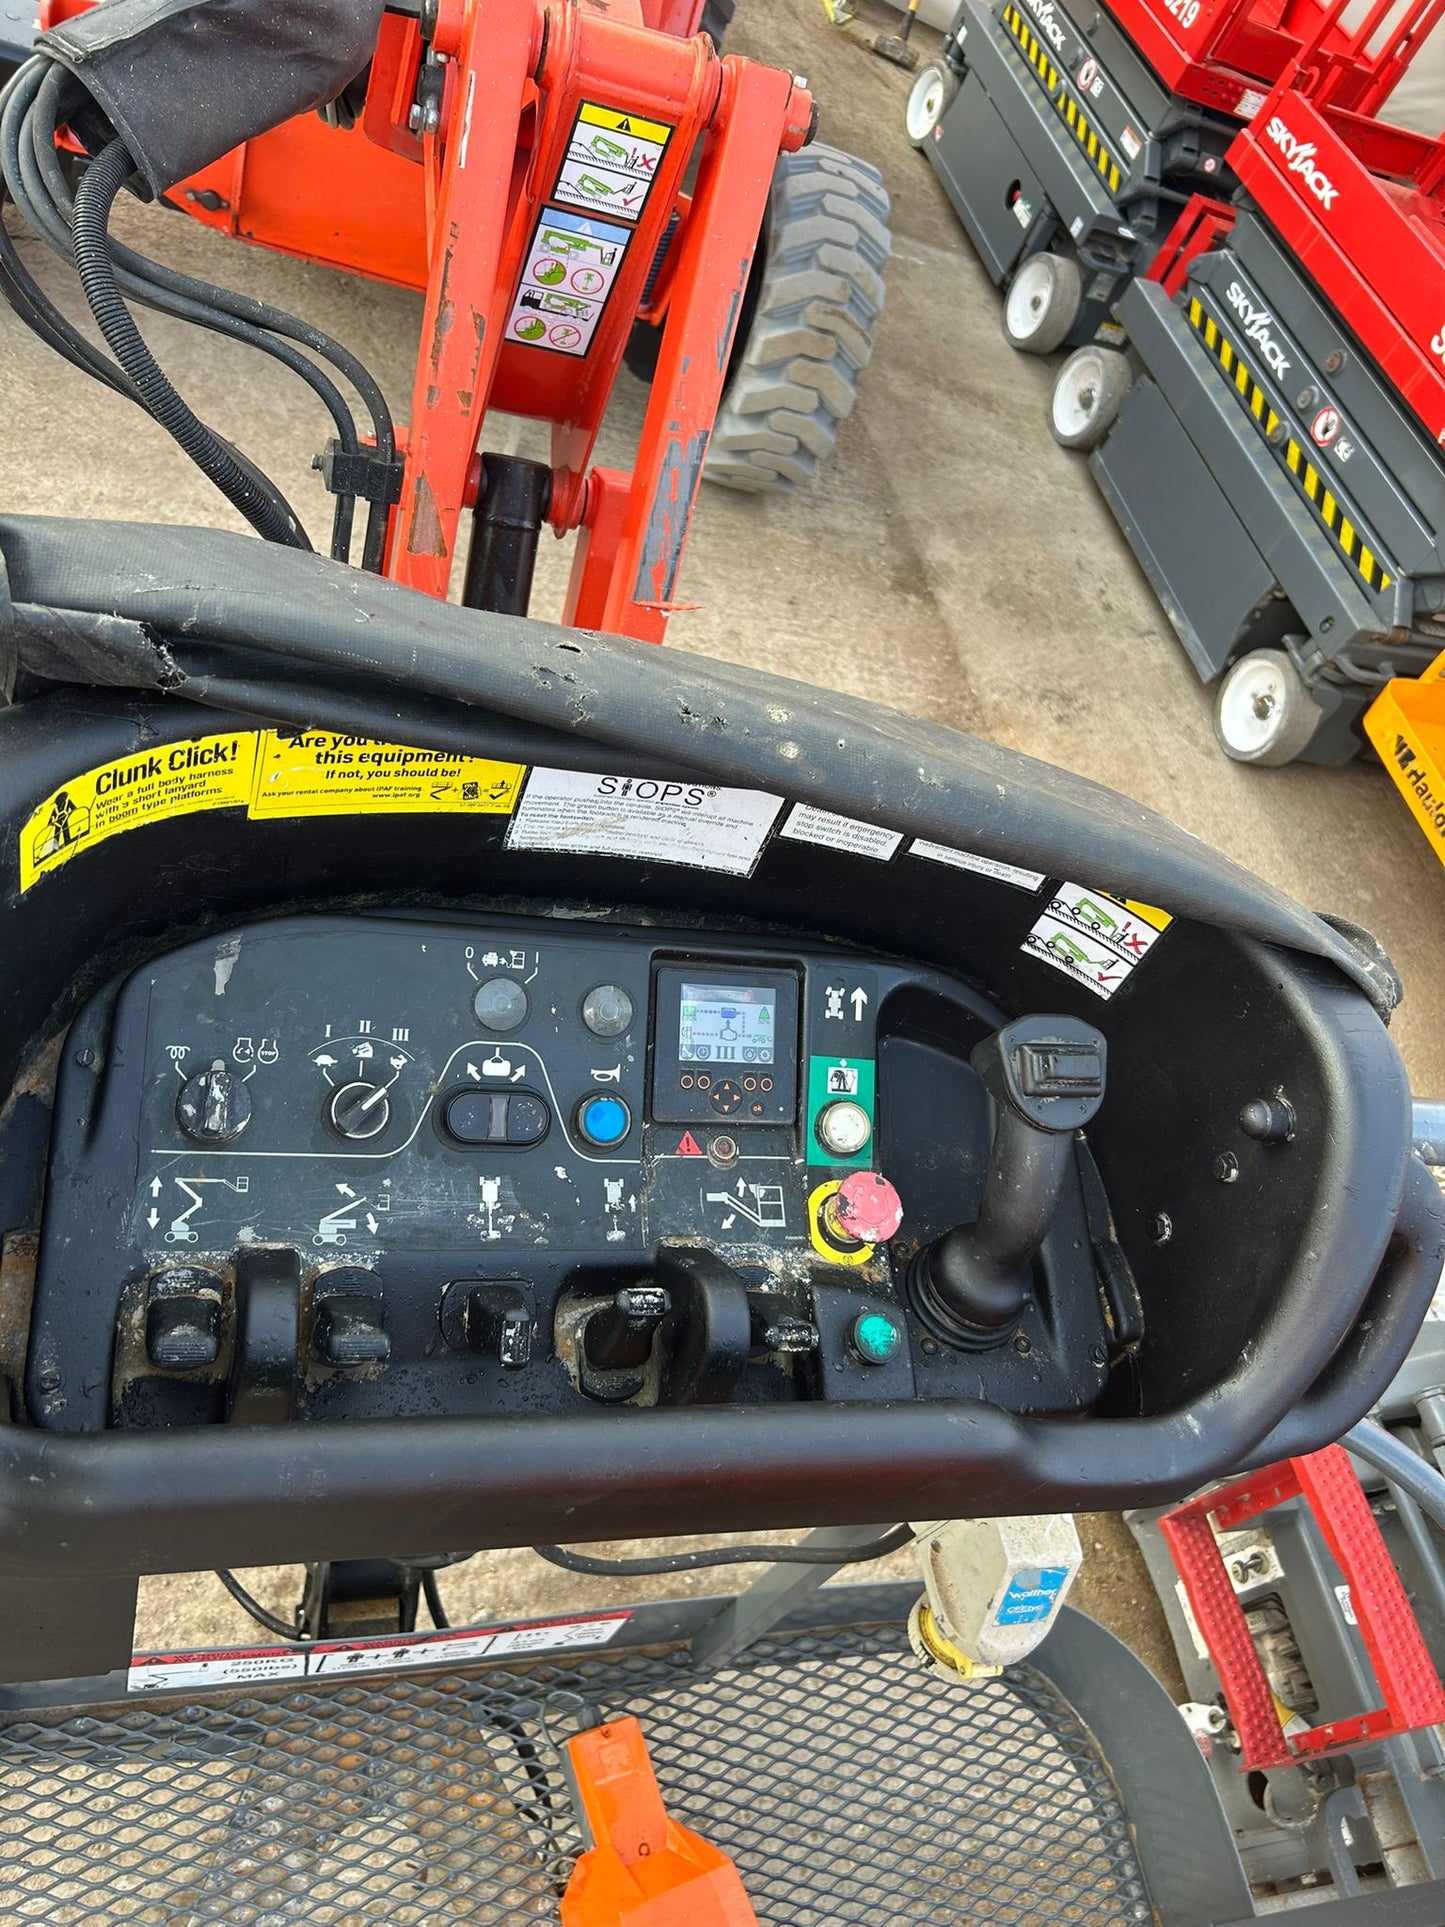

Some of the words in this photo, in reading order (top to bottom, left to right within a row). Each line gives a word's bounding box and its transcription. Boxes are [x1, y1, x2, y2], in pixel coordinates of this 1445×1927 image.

[1026, 0, 1066, 51] KYJACK
[1164, 0, 1200, 28] 219
[1265, 116, 1339, 211] SKYJACK
[1225, 281, 1291, 381] SKYJACK
[288, 735, 327, 749] Are
[331, 735, 368, 750] you
[315, 750, 354, 764] this
[95, 756, 163, 796] Clunk
[168, 740, 238, 771] Click!
[325, 769, 337, 779] If
[338, 769, 364, 780] not,
[367, 769, 392, 780] you
[393, 768, 439, 778] should
[441, 768, 462, 778] be!
[95, 802, 119, 820] with
[132, 790, 161, 805] short
[164, 779, 206, 795] lanyard
[96, 794, 123, 811] Wear
[126, 790, 134, 798] a
[137, 782, 155, 795] full
[158, 775, 186, 788] body
[189, 767, 234, 781] harness
[319, 787, 353, 795] company
[95, 819, 106, 829] in
[109, 807, 139, 824] boom
[141, 797, 167, 811] type
[170, 786, 223, 804] platforms
[544, 794, 573, 802] operator
[727, 817, 754, 827] machine
[597, 803, 620, 812] button
[792, 827, 825, 840] blocked
[795, 820, 814, 830] stop
[815, 824, 842, 835] switch
[797, 811, 817, 822] may
[817, 815, 841, 826] result
[841, 820, 849, 828] if
[849, 824, 896, 841] emergency
[236, 1671, 281, 1680] MAX
